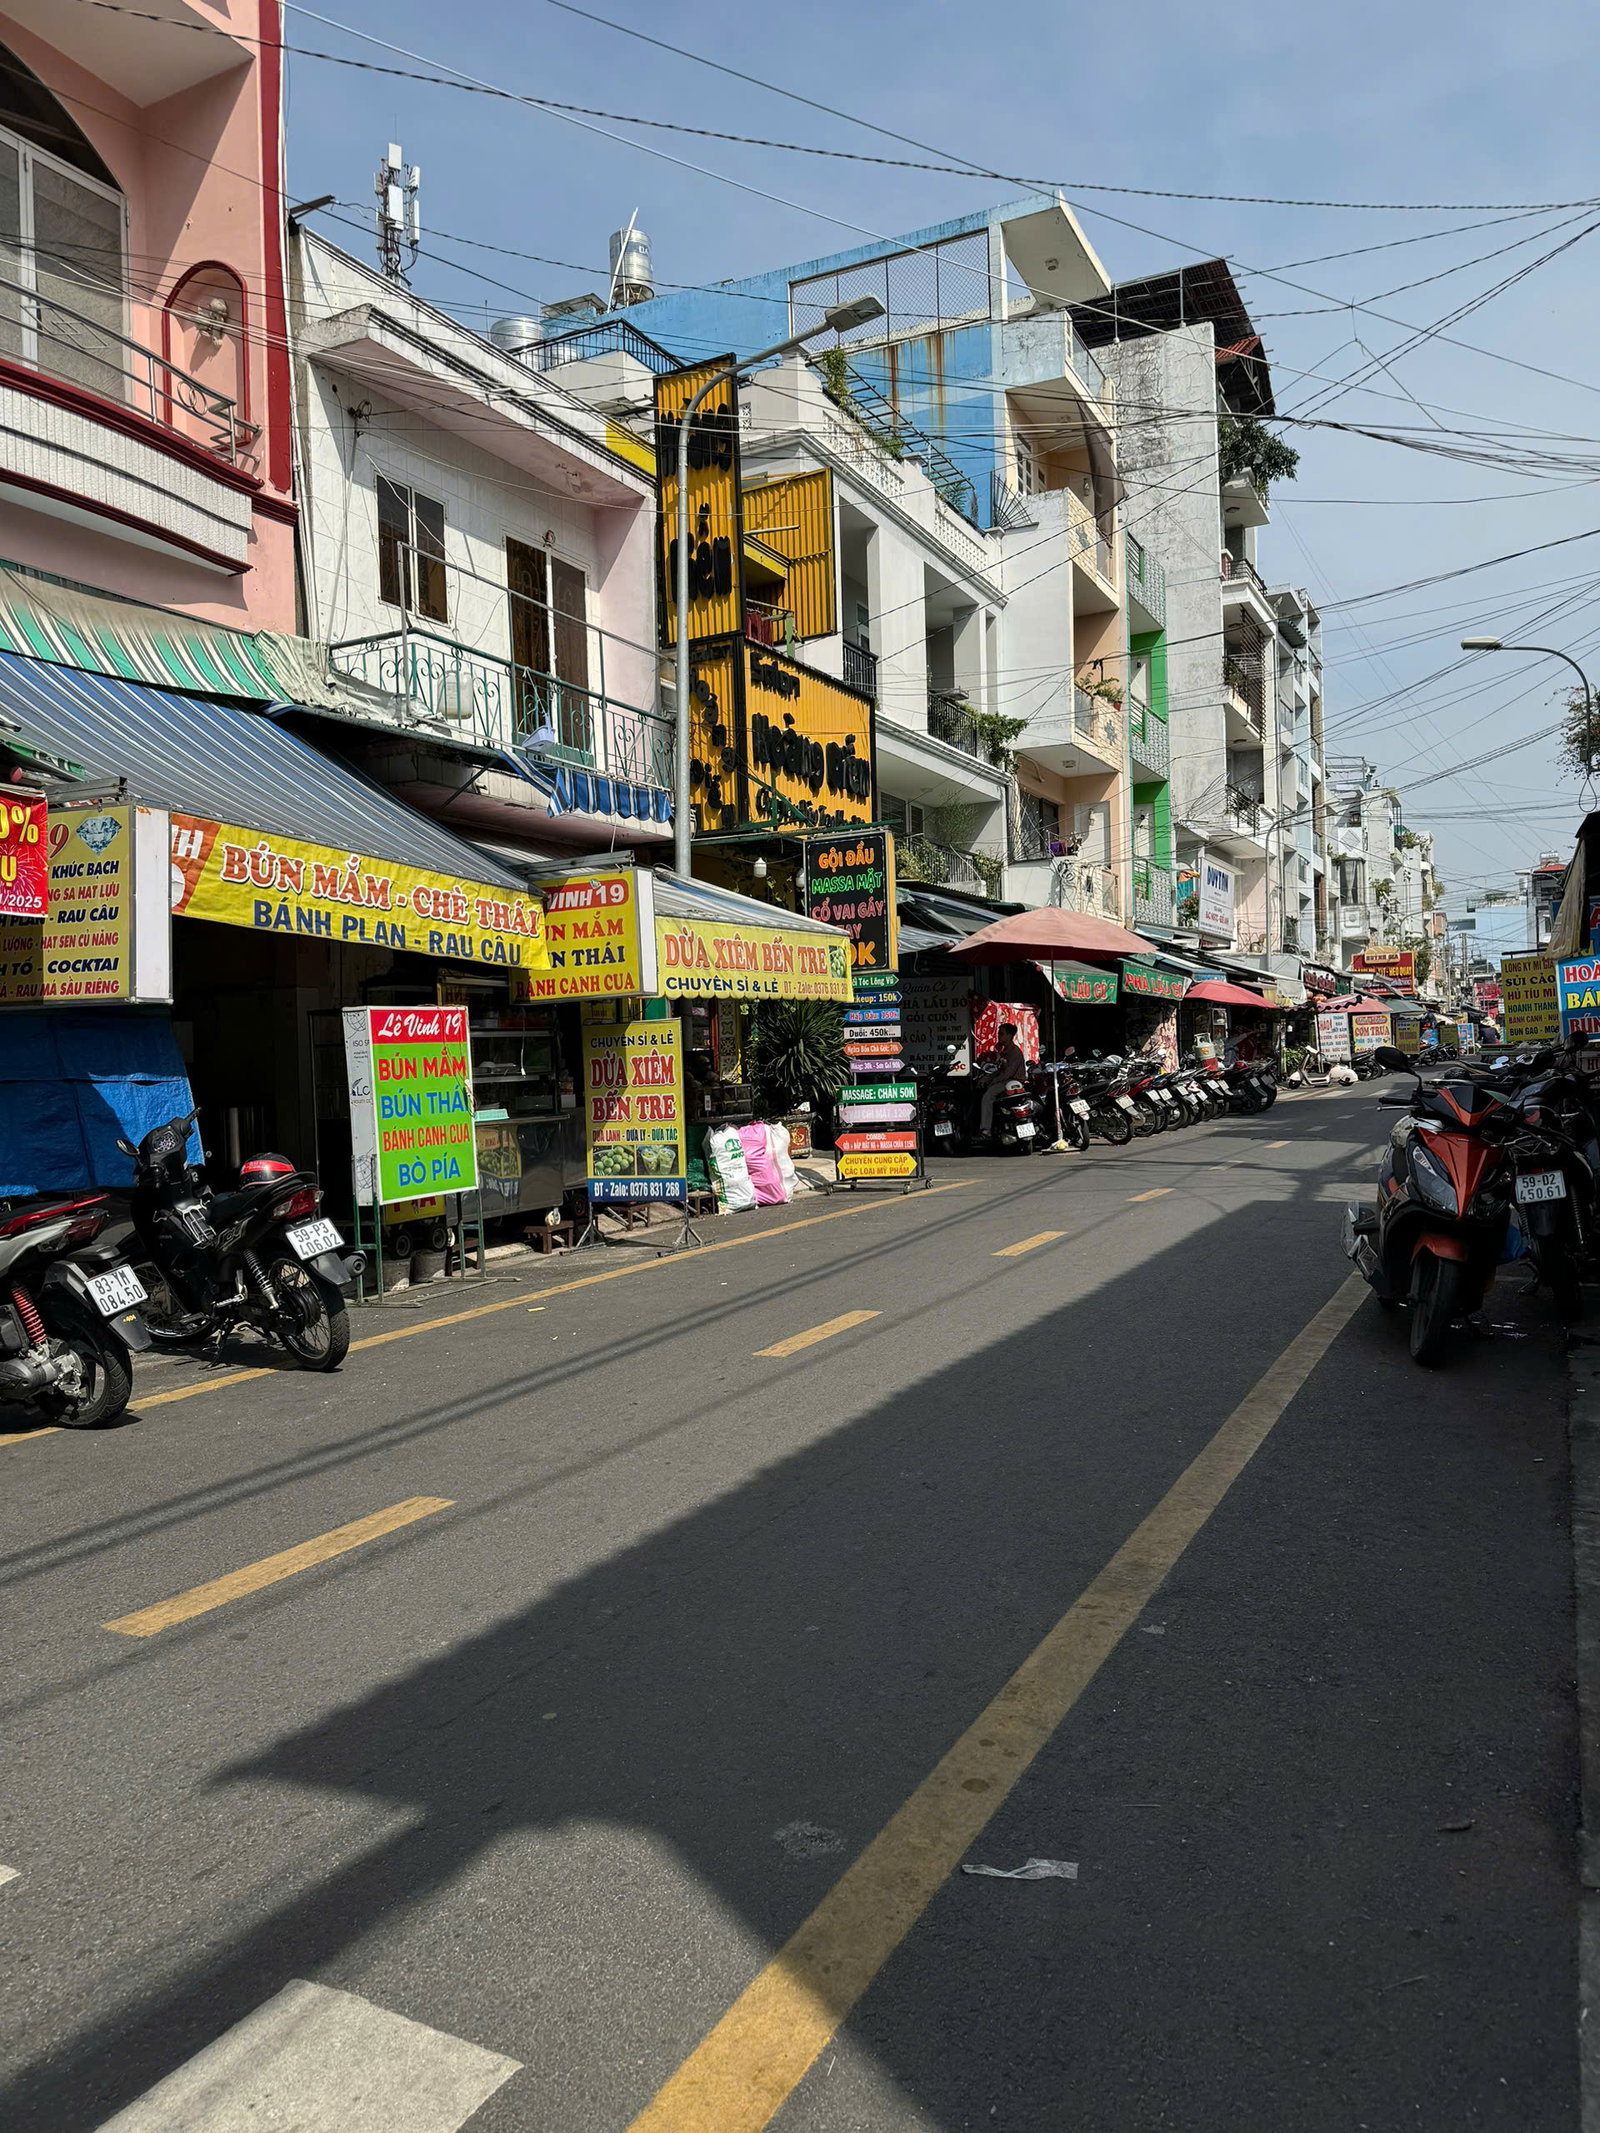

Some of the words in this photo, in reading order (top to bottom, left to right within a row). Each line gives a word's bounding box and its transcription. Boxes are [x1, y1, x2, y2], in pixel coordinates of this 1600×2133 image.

[52, 861, 84, 879] KHÚC
[87, 860, 119, 880] BẠCH
[818, 847, 843, 873] GỘI
[221, 841, 304, 894] BÚN
[310, 854, 392, 910] MẮM
[411, 885, 469, 925] CHÈ
[474, 898, 540, 937] THÁI
[812, 875, 854, 895] MASSA
[856, 867, 882, 894] MẶT
[63, 887, 76, 900] SA
[78, 885, 98, 903] HẠT
[595, 883, 624, 904] 19
[57, 909, 86, 923] RAU
[89, 904, 119, 921] CÂU
[812, 897, 831, 921] CỔ
[832, 903, 855, 920] VAI
[857, 896, 884, 918] GÁY
[254, 897, 332, 937] BÁNH
[342, 915, 406, 949] PLAN
[429, 929, 474, 958] RAU
[480, 935, 521, 966] CÂU
[572, 911, 624, 940] MẮM
[41, 936, 58, 952] HẠT
[59, 935, 76, 949] SEN
[571, 942, 626, 967] THÁI
[664, 926, 710, 969] DỪA
[712, 933, 759, 971] XIÊM
[761, 936, 794, 973] BẾN
[797, 946, 828, 975] TRE
[47, 957, 119, 974] COCKTAI
[1504, 962, 1522, 973] LONG
[16, 983, 37, 998] RAU
[40, 979, 57, 997] MÁ
[60, 975, 82, 996] SẦU
[84, 977, 119, 995] RIÊNG
[516, 976, 556, 998] BÁNH
[559, 975, 600, 995] CANH
[603, 972, 635, 992] CUA
[665, 975, 733, 991] CHUYÊN
[736, 976, 749, 992] SỈ
[752, 981, 761, 993] &
[764, 978, 779, 993] LẺ
[1505, 974, 1526, 987] SỦI
[1530, 973, 1555, 985] CẢO
[878, 992, 897, 1002] 150k
[378, 1013, 402, 1037] Lê
[403, 1013, 440, 1037] Vinh
[444, 1012, 462, 1036] 19
[928, 1010, 957, 1022] CUỐN
[591, 1034, 635, 1048] CHUYÊN
[650, 1034, 657, 1045] &
[661, 1030, 674, 1044] LẺ
[378, 1052, 417, 1081] BÚN
[423, 1046, 467, 1078] MẮM
[591, 1050, 628, 1088] DỪA
[631, 1048, 675, 1086] XIÊM
[381, 1088, 421, 1119] BÚN
[842, 1089, 876, 1100] MASSAGE:
[877, 1085, 898, 1099] CHÂN
[899, 1087, 914, 1098] 50K
[592, 1089, 631, 1121] BẾN
[635, 1095, 676, 1120] TRE
[383, 1126, 415, 1152] BÁNH
[417, 1125, 447, 1148] CANH
[449, 1123, 470, 1144] CUA
[398, 1155, 426, 1187] BÒ
[432, 1152, 461, 1181] PÍA
[1522, 1173, 1556, 1189] 59-D2
[610, 1182, 629, 1196] Zalo:
[630, 1181, 648, 1196] 0376
[649, 1182, 663, 1196] 831
[665, 1182, 680, 1196] 268
[1519, 1185, 1562, 1202] 450.61
[293, 1222, 330, 1243] 59-P3
[299, 1233, 341, 1257] 406.02
[100, 1284, 143, 1313] 084.50
